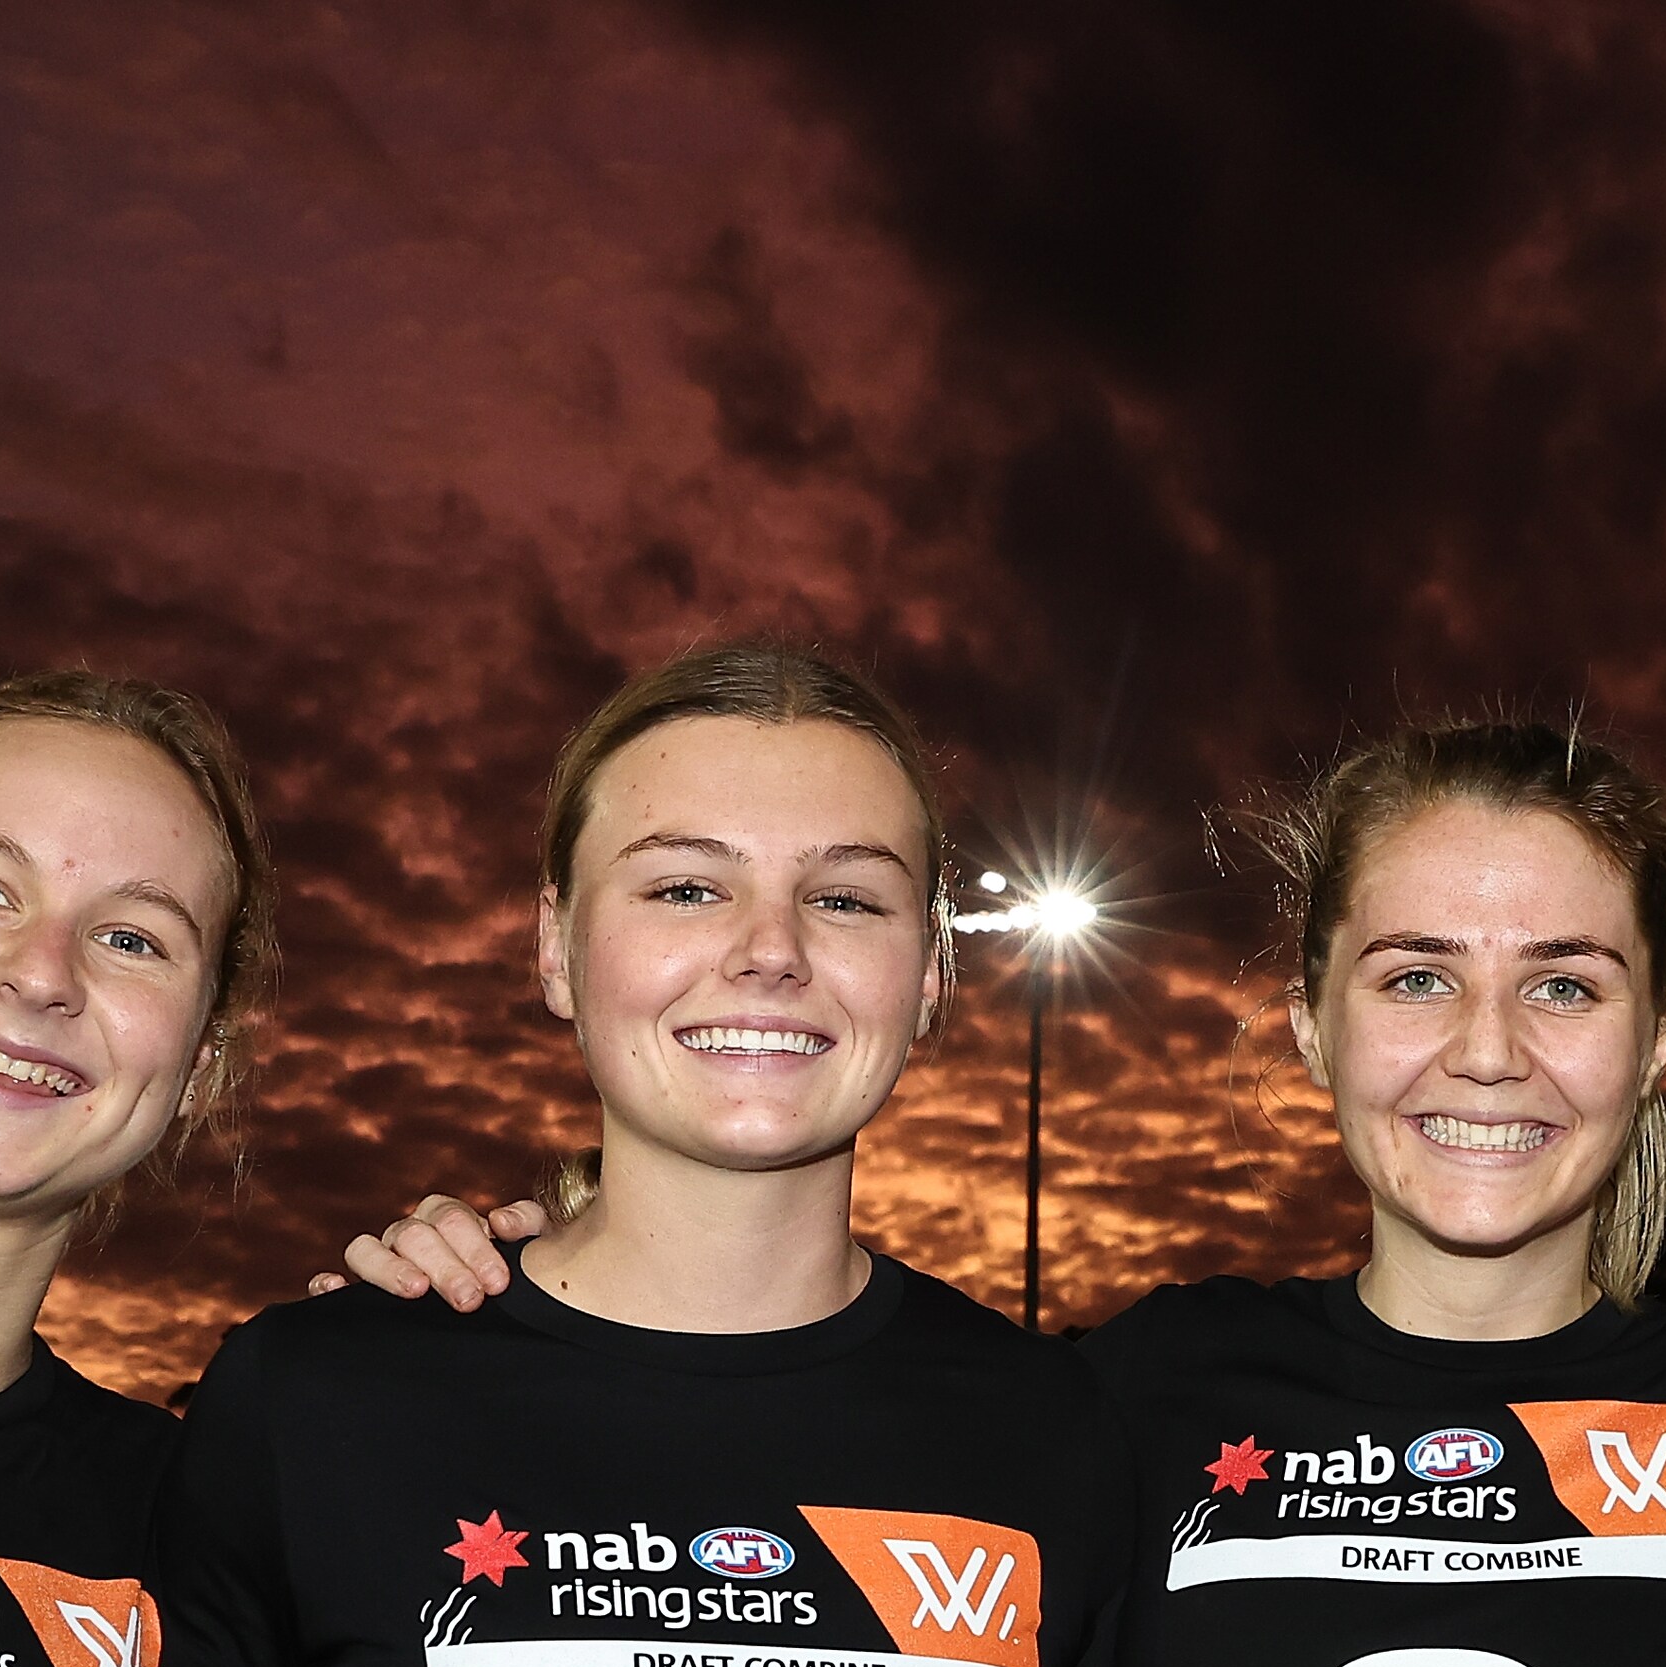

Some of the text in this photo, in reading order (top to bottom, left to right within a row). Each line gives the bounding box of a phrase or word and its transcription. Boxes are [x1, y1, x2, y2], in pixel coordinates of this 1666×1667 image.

[1283, 1433, 1497, 1485] nab AFL
[543, 1522, 789, 1572] nab AFL
[1341, 1546, 1583, 1572] DRAFT COMBINE
